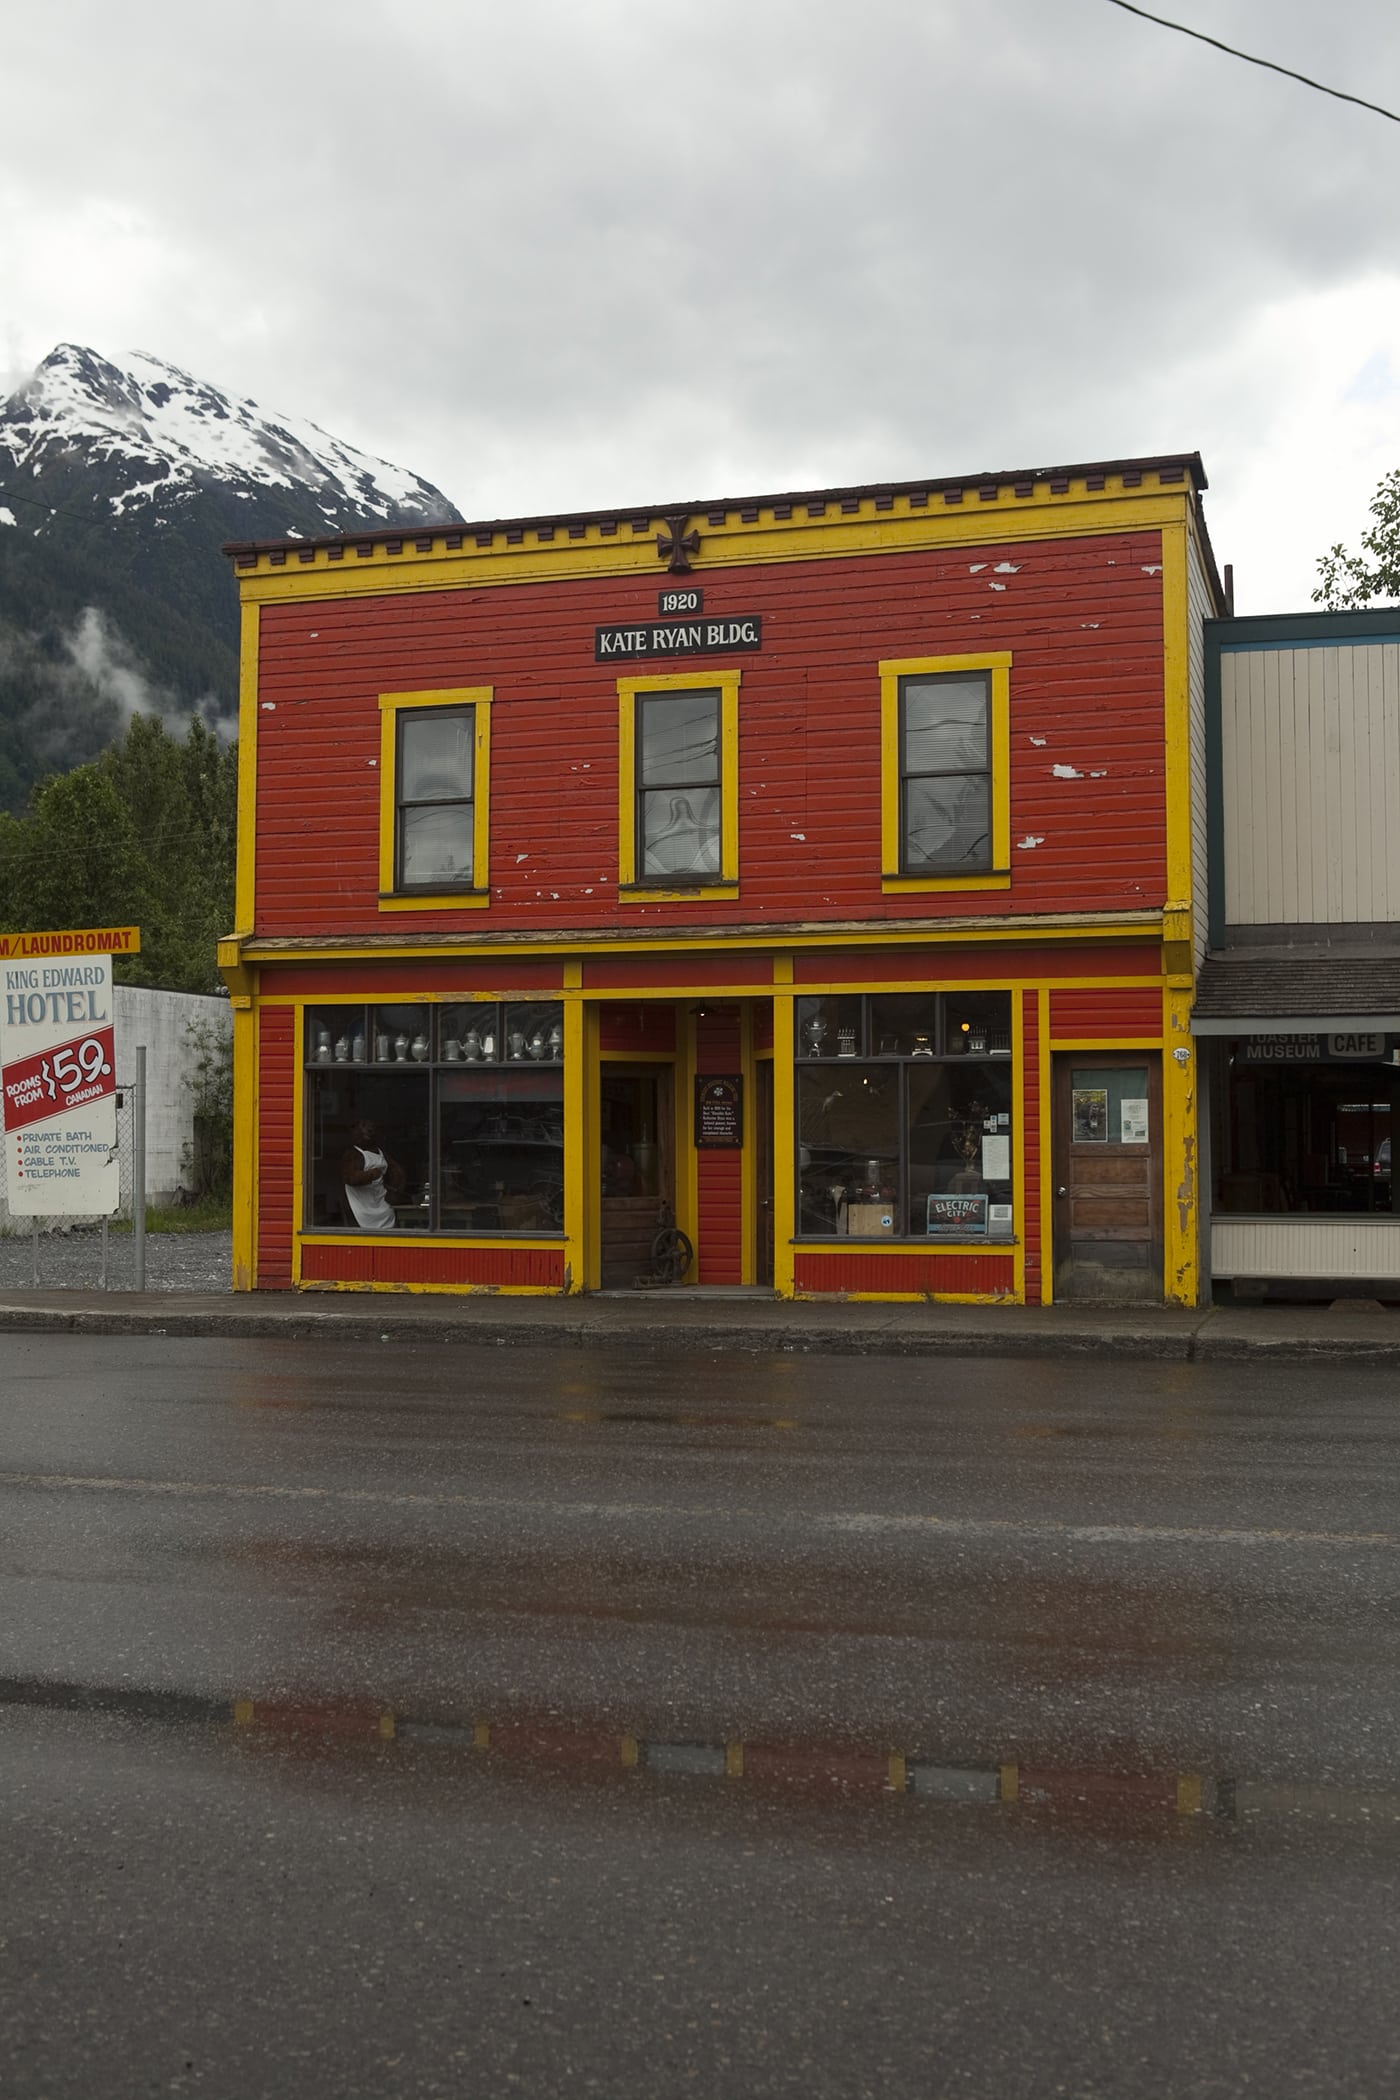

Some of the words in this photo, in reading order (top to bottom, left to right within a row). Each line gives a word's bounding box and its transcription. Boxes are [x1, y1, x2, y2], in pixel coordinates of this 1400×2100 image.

[662, 592, 697, 611] 1920
[600, 630, 647, 653] KATE
[652, 626, 702, 649] RYAN
[707, 622, 759, 646] BLDG.
[6, 970, 39, 990] KING
[43, 966, 105, 988] EDWARD
[6, 990, 107, 1025] HOTEL
[1247, 1044, 1320, 1059] MUSEUM
[1334, 1035, 1377, 1052] CAFE
[6, 1075, 41, 1098] ROOMS
[65, 1084, 103, 1106] CANADIAN
[14, 1087, 44, 1108] FROM
[23, 1132, 62, 1142] PRIVATE
[66, 1131, 92, 1141] BATH
[23, 1145, 41, 1154] AIR
[45, 1144, 109, 1153] CONDITIONED
[24, 1157, 54, 1166] CABLE
[59, 1156, 77, 1165] T.V.
[25, 1168, 81, 1179] TELEPHONE
[935, 1200, 980, 1213] ELECTRIC
